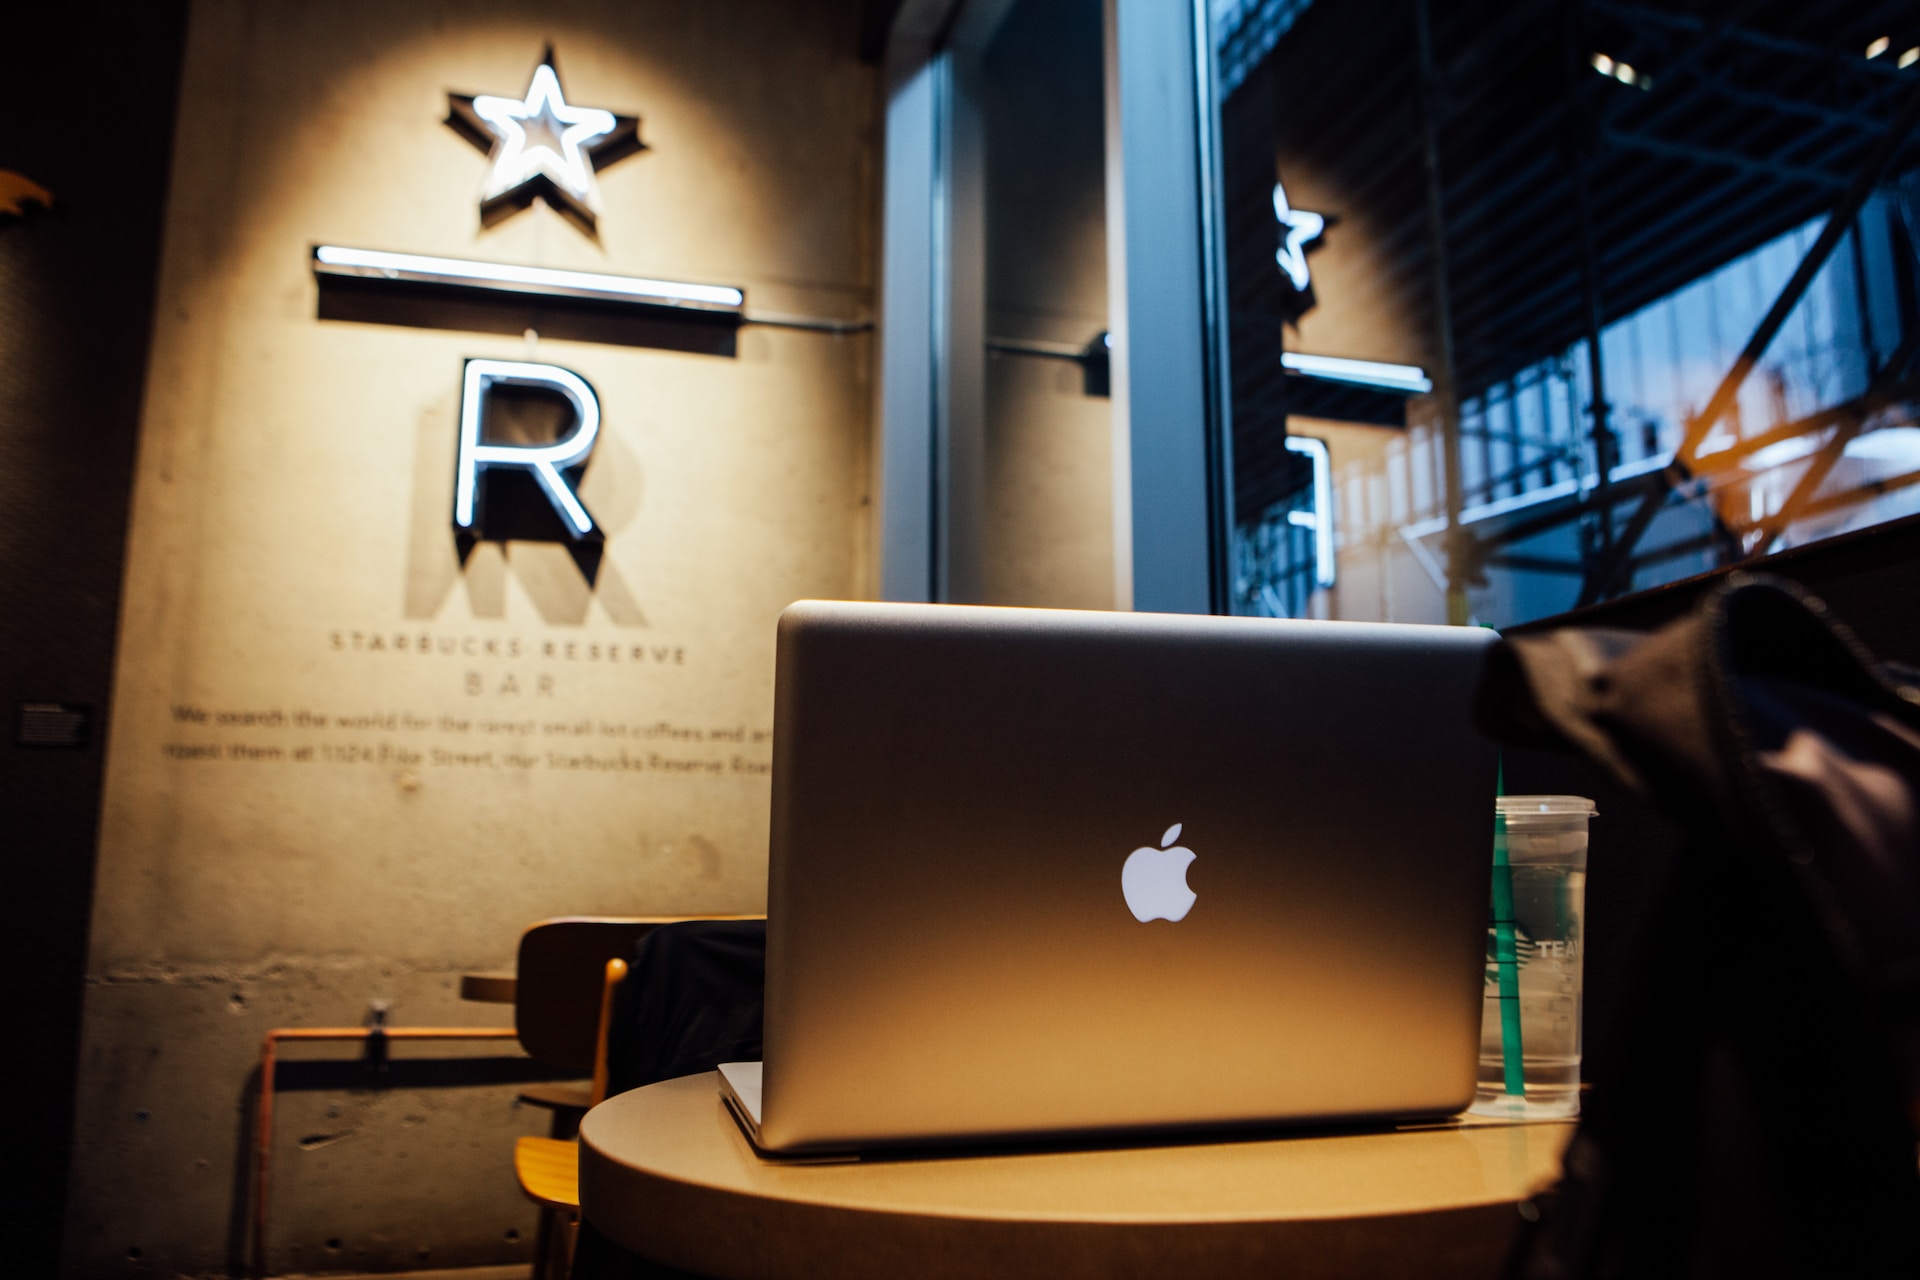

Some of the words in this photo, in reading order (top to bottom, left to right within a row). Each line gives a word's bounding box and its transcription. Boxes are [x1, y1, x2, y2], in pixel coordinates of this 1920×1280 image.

[453, 357, 604, 545] R
[328, 630, 522, 659] STARBUCKS
[541, 640, 687, 667] RESERVE
[465, 670, 556, 698] BAR
[170, 703, 210, 726] We
[215, 708, 286, 728] search
[291, 707, 329, 729] the
[335, 710, 398, 731] world
[402, 710, 431, 731] for
[436, 713, 471, 734] the
[631, 721, 703, 742] coffees
[709, 723, 746, 743] and
[226, 742, 286, 762] them
[291, 744, 314, 763] at
[546, 748, 643, 772] Starbucks
[647, 752, 724, 774] Reserve
